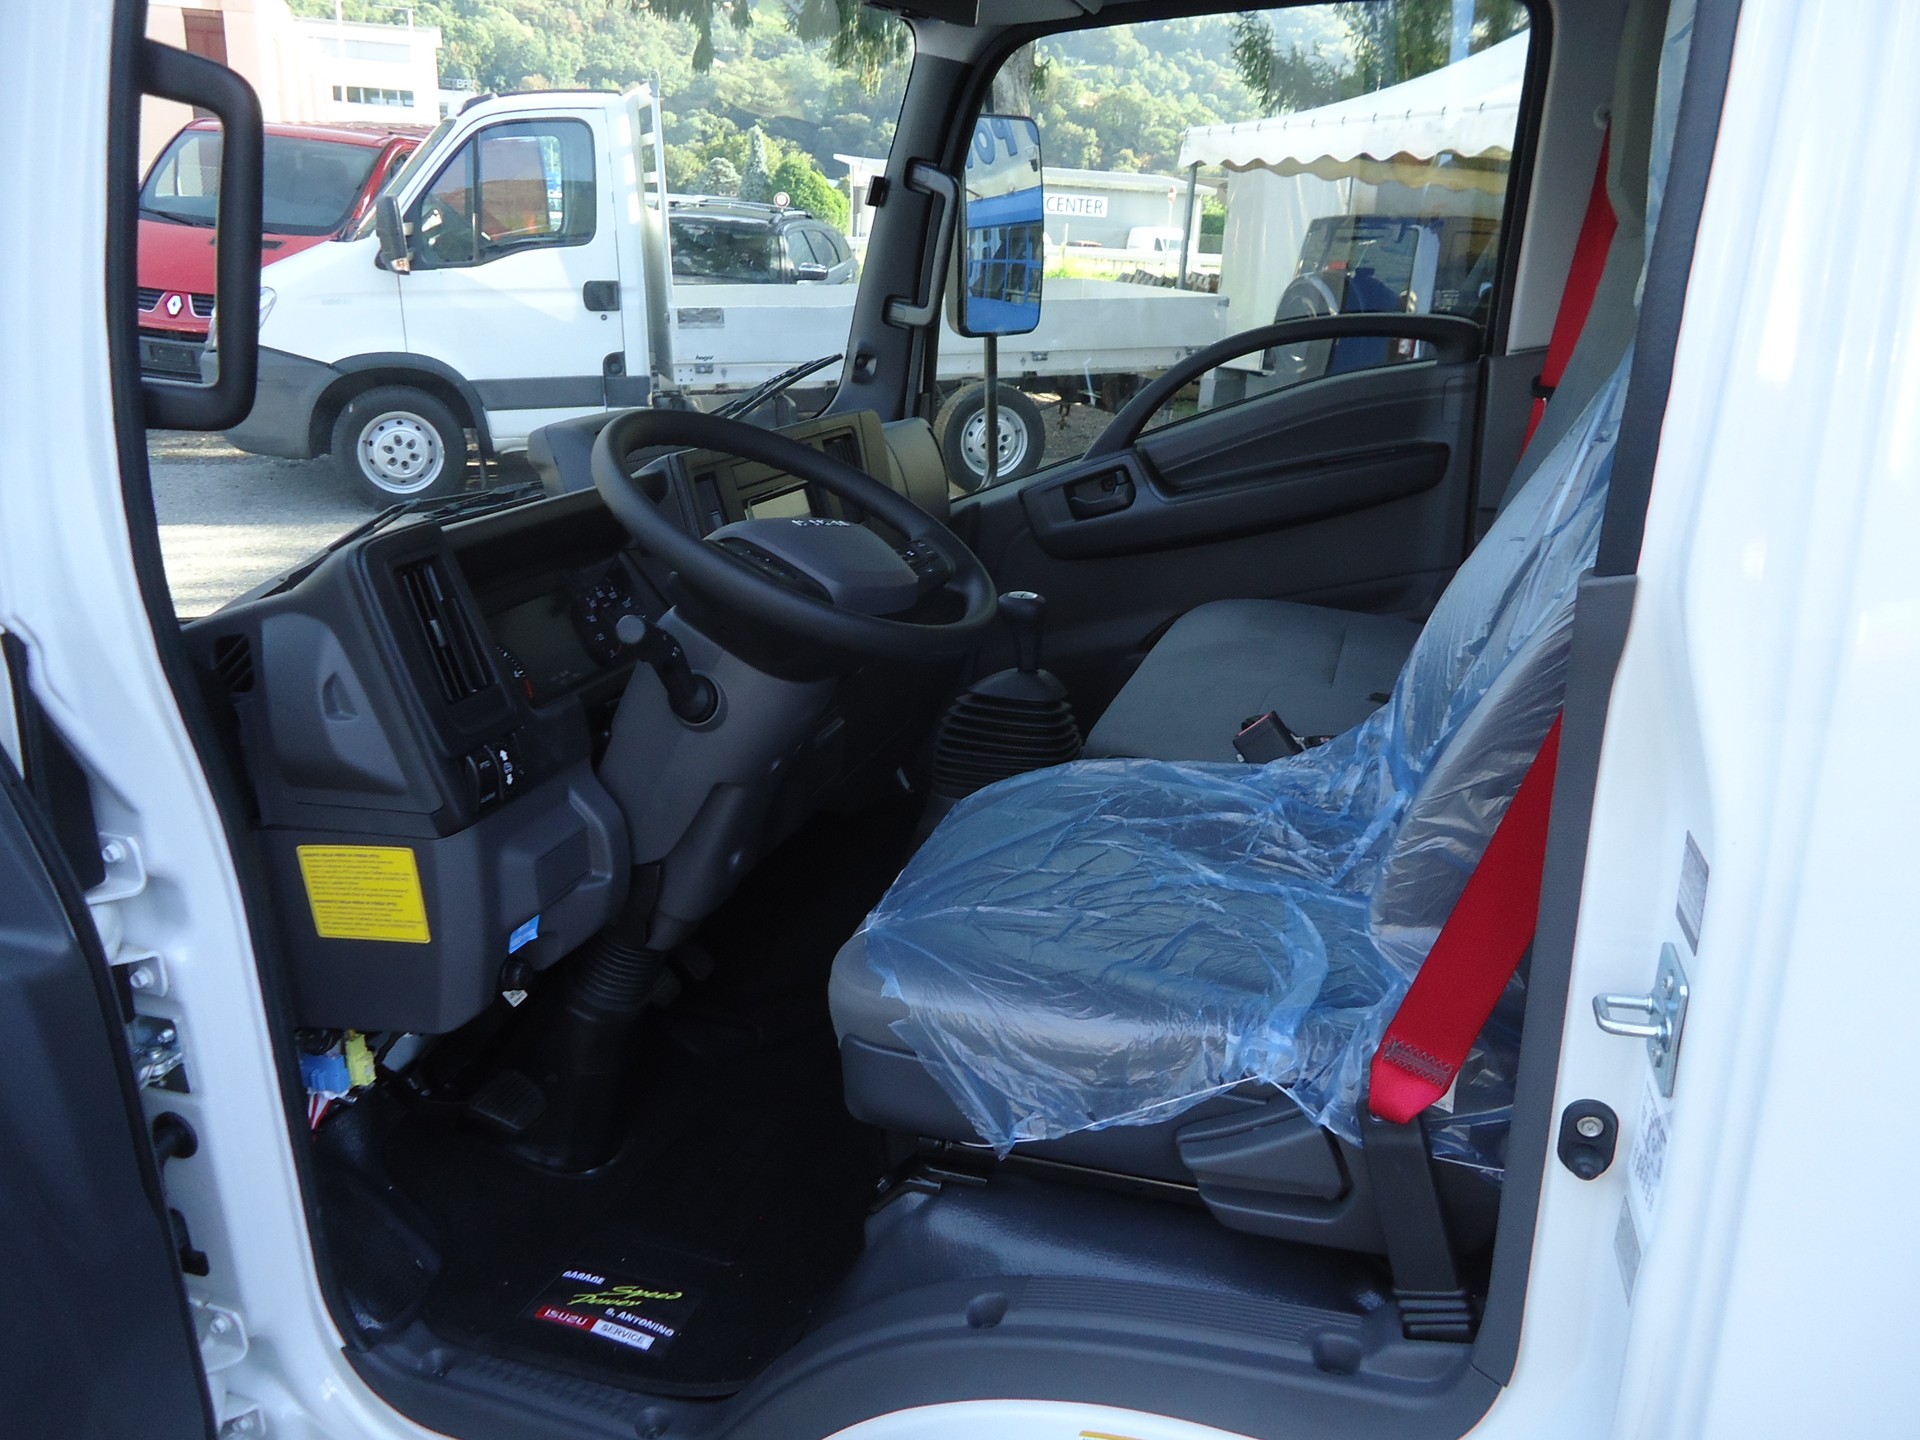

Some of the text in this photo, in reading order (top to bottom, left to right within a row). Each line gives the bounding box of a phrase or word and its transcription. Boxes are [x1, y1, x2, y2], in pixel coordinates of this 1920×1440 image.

[1046, 196, 1103, 215] CENTER
[562, 1270, 606, 1285] GARAGE
[544, 1308, 648, 1343] ISUZU SERVICE
[617, 1311, 675, 1337] ANTONINO
